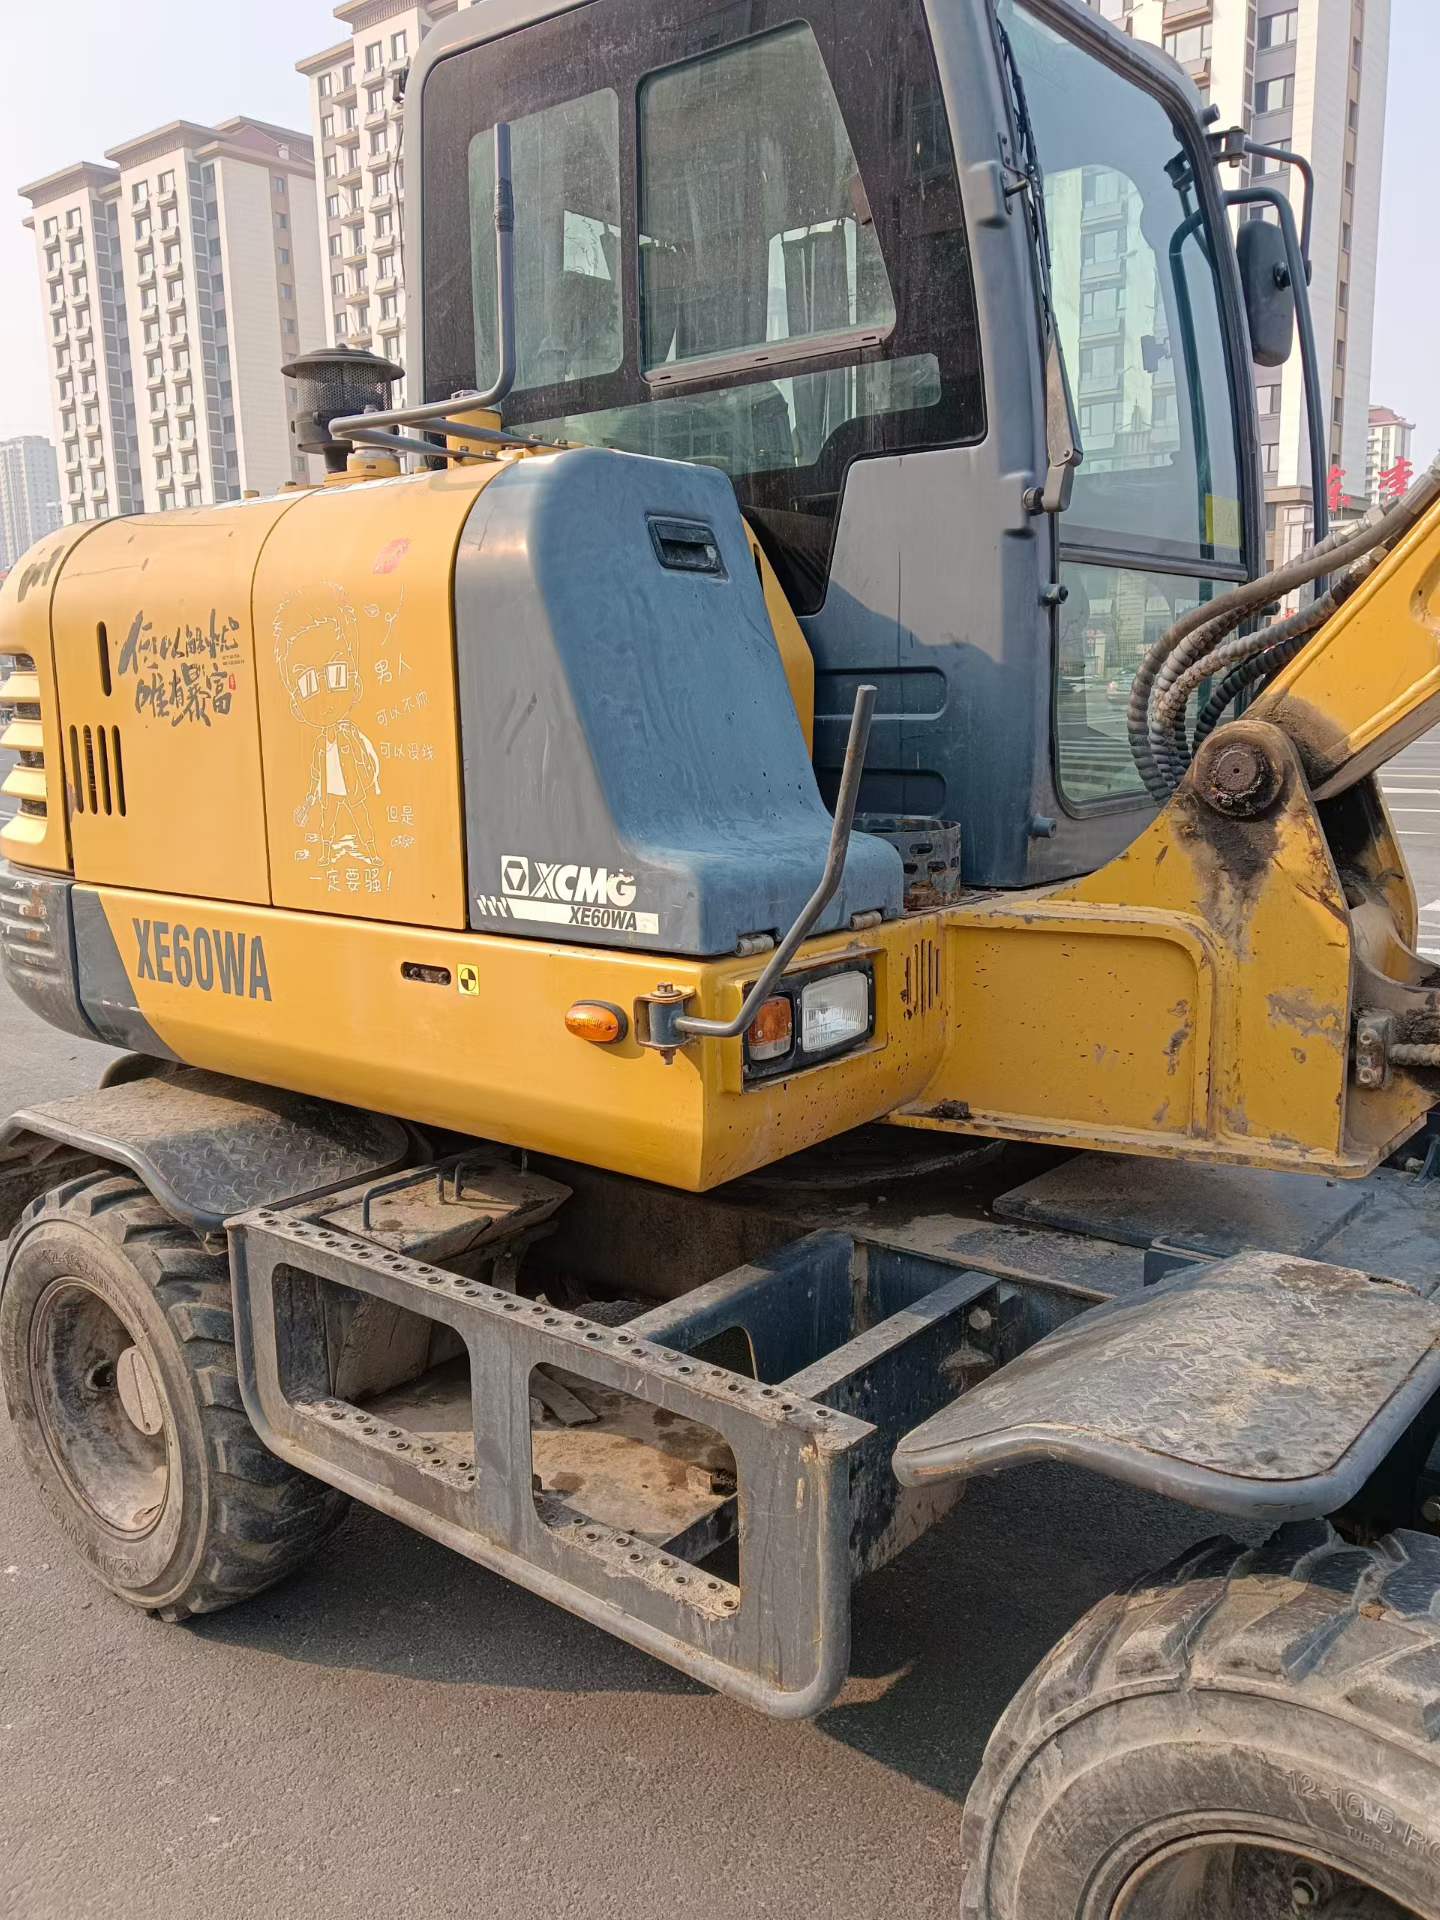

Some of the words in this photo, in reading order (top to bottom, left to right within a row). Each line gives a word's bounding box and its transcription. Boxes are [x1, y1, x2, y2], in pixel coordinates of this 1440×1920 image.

[374, 653, 413, 686] 男人
[135, 662, 233, 727] 唯有暴富
[376, 689, 430, 727] 可以不帅
[379, 742, 435, 761] 可以没钱
[386, 803, 416, 826] 但是
[530, 862, 637, 907] XCMG
[568, 906, 638, 931] XE60WA
[132, 917, 273, 1002] XE60WA
[1282, 1769, 1396, 1834] 12-16.5
